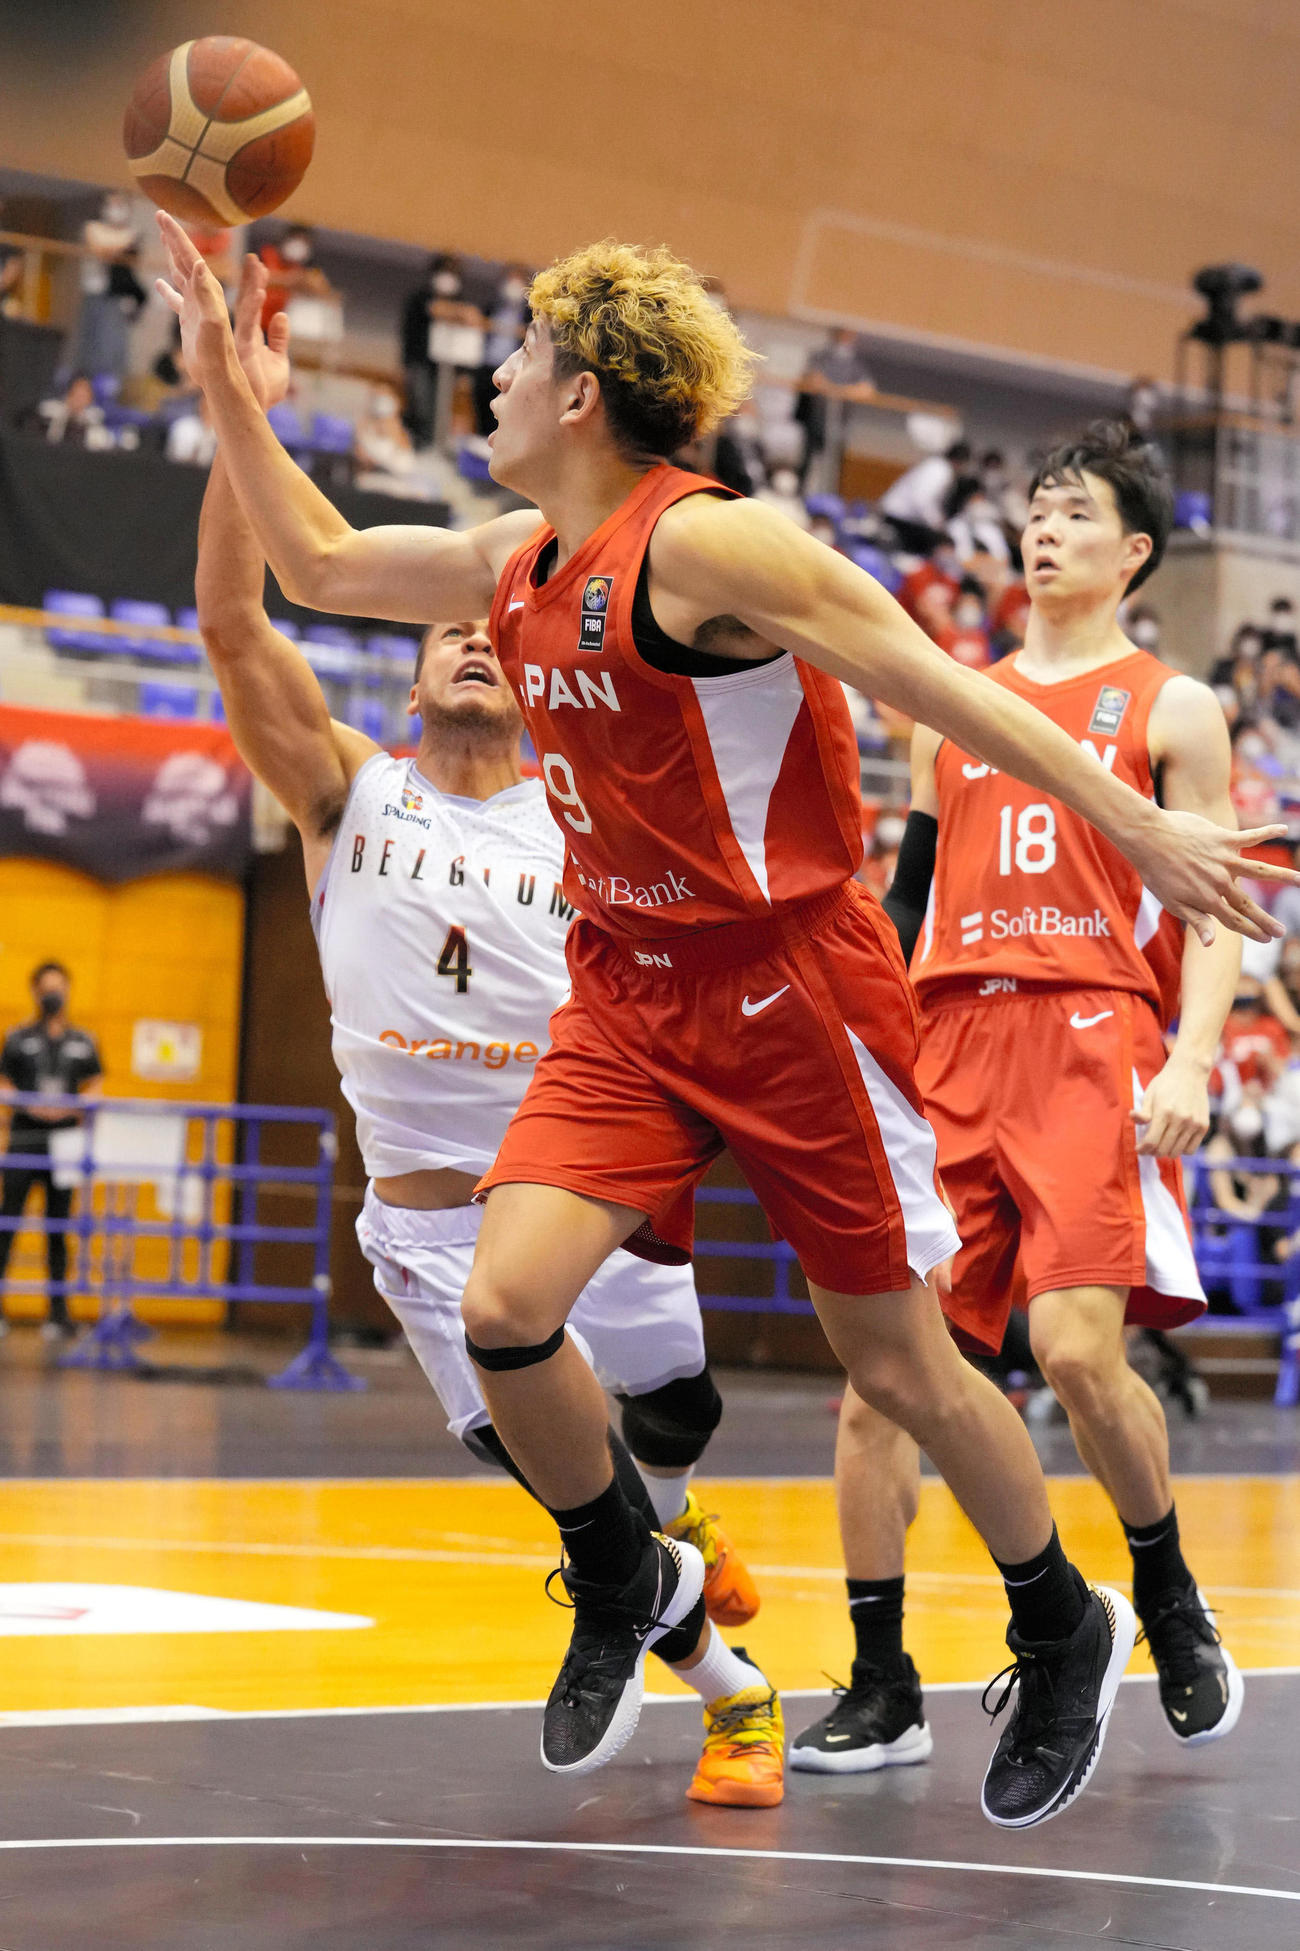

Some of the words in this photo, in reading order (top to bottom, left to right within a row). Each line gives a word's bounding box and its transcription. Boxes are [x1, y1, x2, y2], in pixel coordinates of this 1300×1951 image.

[585, 618, 601, 632] FIBA
[519, 663, 622, 712] PAN
[543, 753, 592, 834] 9
[382, 803, 432, 830] SPALDING
[1000, 803, 1056, 876] 18
[351, 833, 575, 921] BELGIUM
[990, 906, 1111, 939] SoftBank
[436, 924, 472, 994] 4
[634, 951, 673, 969] JPN
[979, 978, 1017, 996] JPN
[379, 1029, 539, 1070] Orange
